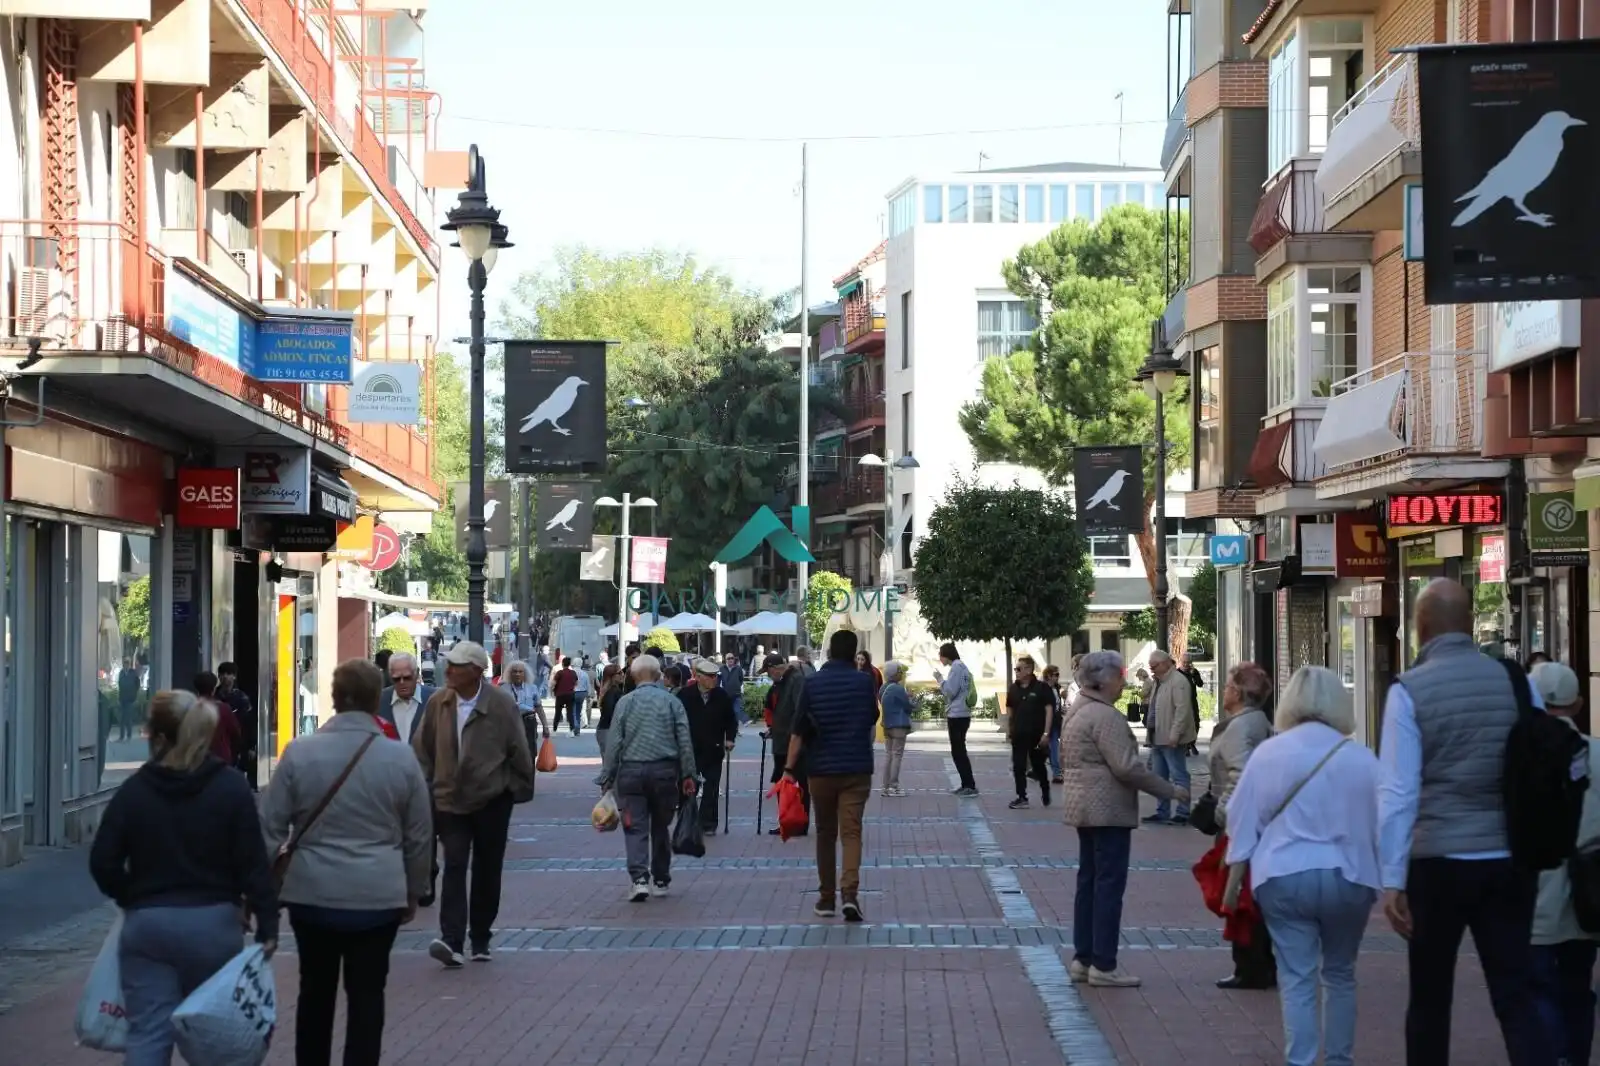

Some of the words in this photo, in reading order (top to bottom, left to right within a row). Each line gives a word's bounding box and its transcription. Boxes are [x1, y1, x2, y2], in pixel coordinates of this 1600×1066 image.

[275, 338, 336, 350] ABOGADOS
[308, 353, 349, 365] FINCAS
[285, 367, 296, 378] 91
[299, 369, 316, 379] 683
[318, 370, 331, 379] 45
[331, 370, 345, 380] 54
[180, 485, 234, 503] GAES
